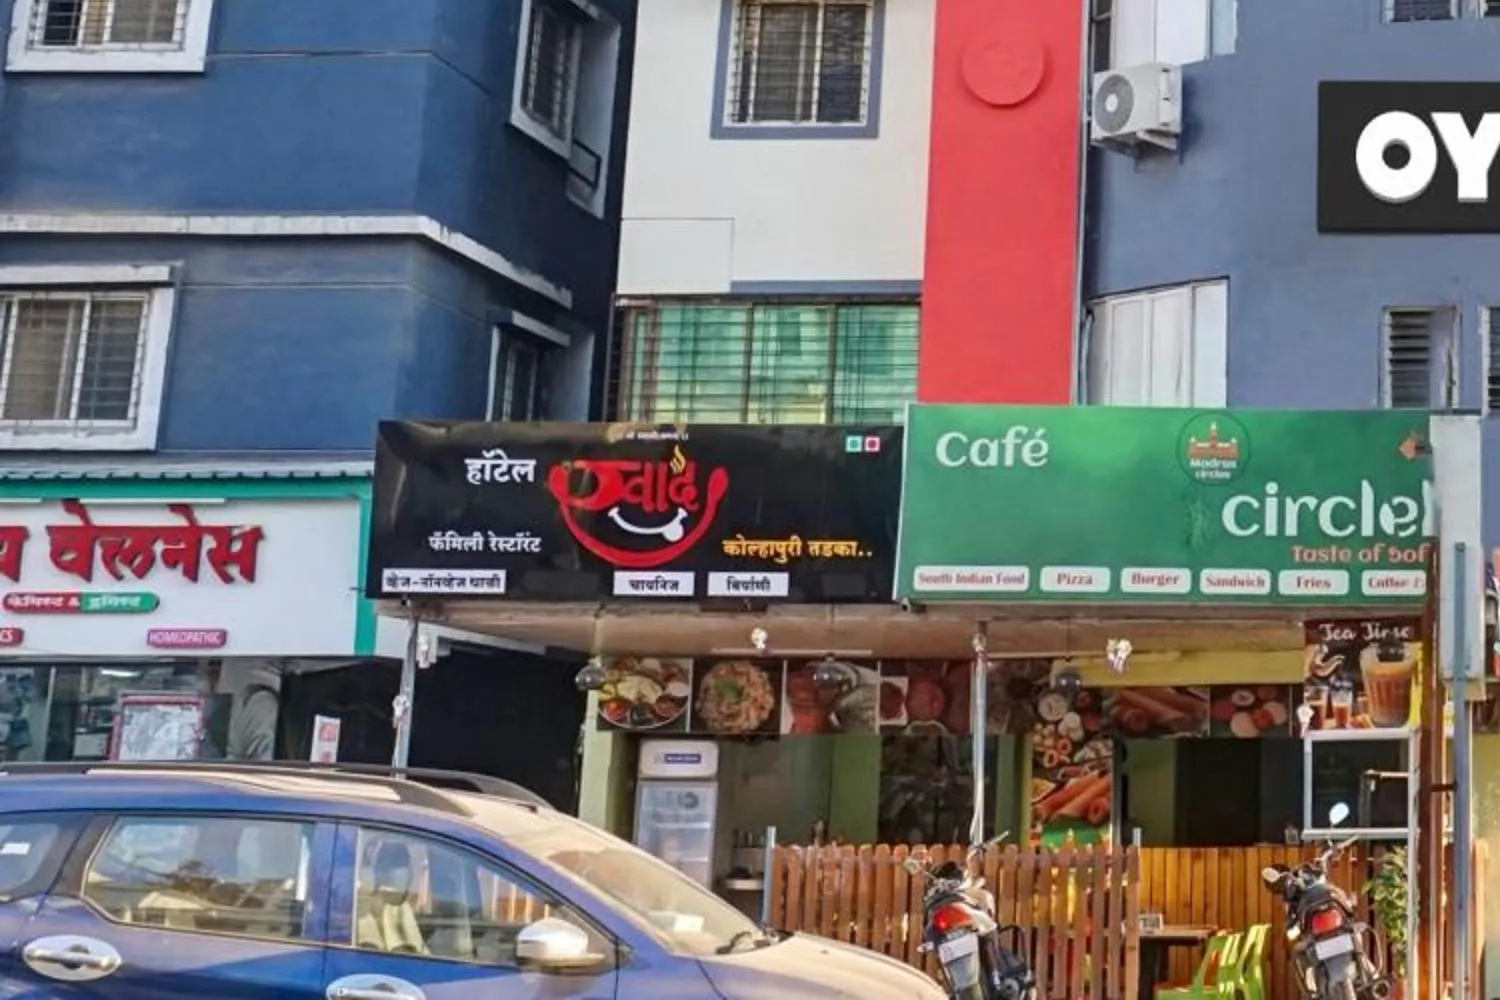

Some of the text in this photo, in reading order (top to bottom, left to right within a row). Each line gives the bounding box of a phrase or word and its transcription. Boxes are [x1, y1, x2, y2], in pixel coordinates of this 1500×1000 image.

[936, 425, 1049, 467] Café
[464, 448, 537, 485] हॉटेल
[46, 498, 264, 583] वेलनेस
[722, 533, 802, 564] कोल्हापुरी
[1359, 542, 1387, 563] of
[954, 567, 993, 585] Indian
[1057, 571, 1093, 586] Pizza
[1131, 571, 1181, 588] Burger
[1206, 573, 1266, 589] Sandwich
[1296, 575, 1332, 589] Fries
[150, 630, 221, 645] HOMEOPATHIC
[1319, 623, 1357, 641] Tea
